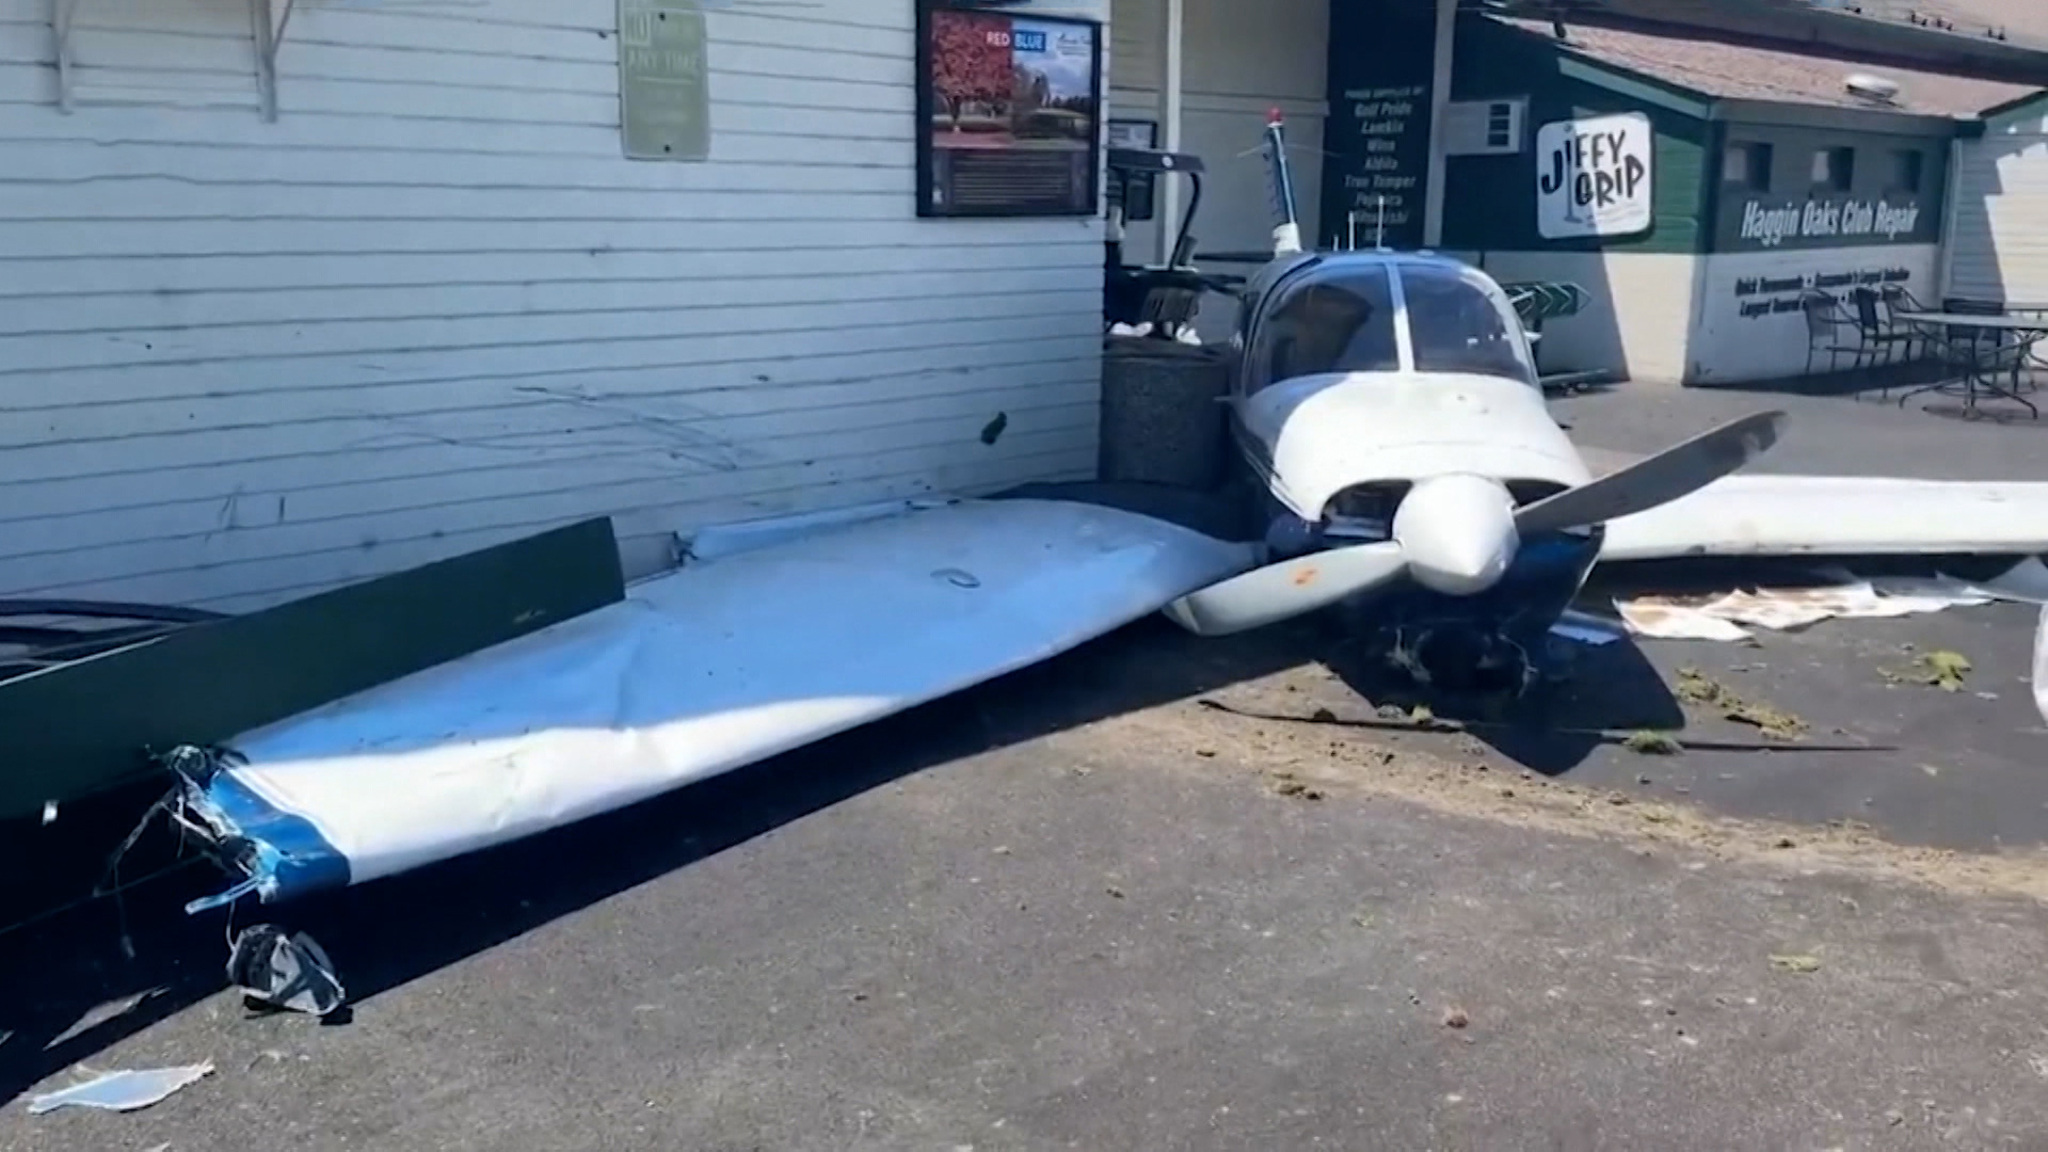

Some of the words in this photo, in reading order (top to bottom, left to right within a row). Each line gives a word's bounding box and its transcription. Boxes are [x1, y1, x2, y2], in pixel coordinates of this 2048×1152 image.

[986, 31, 1010, 47] RED
[1014, 32, 1044, 49] BLUE
[1355, 102, 1379, 117] Golf
[1741, 200, 1799, 247] Haggin
[1802, 200, 1840, 236] Oaks
[1841, 199, 1873, 234] Club
[1874, 199, 1919, 241] Repair
